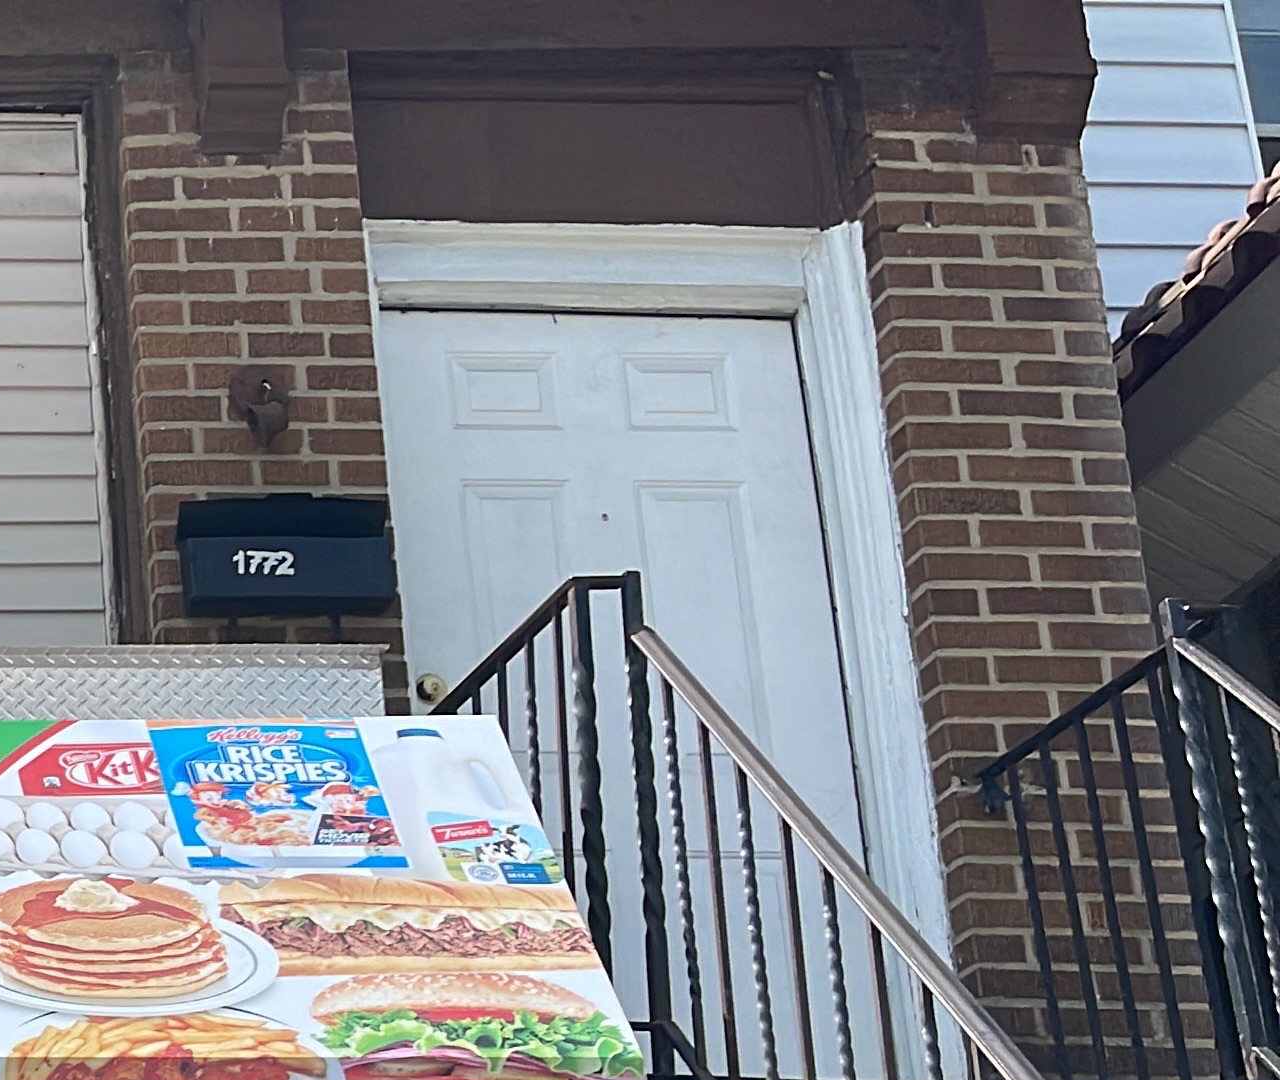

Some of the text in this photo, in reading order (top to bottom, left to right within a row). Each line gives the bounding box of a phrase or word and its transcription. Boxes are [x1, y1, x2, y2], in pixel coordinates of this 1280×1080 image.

[232, 550, 295, 576] 1772
[207, 728, 302, 744] Kellogg's
[225, 744, 301, 763] RICE
[85, 750, 162, 786] KitK
[195, 761, 347, 783] KRISPIES
